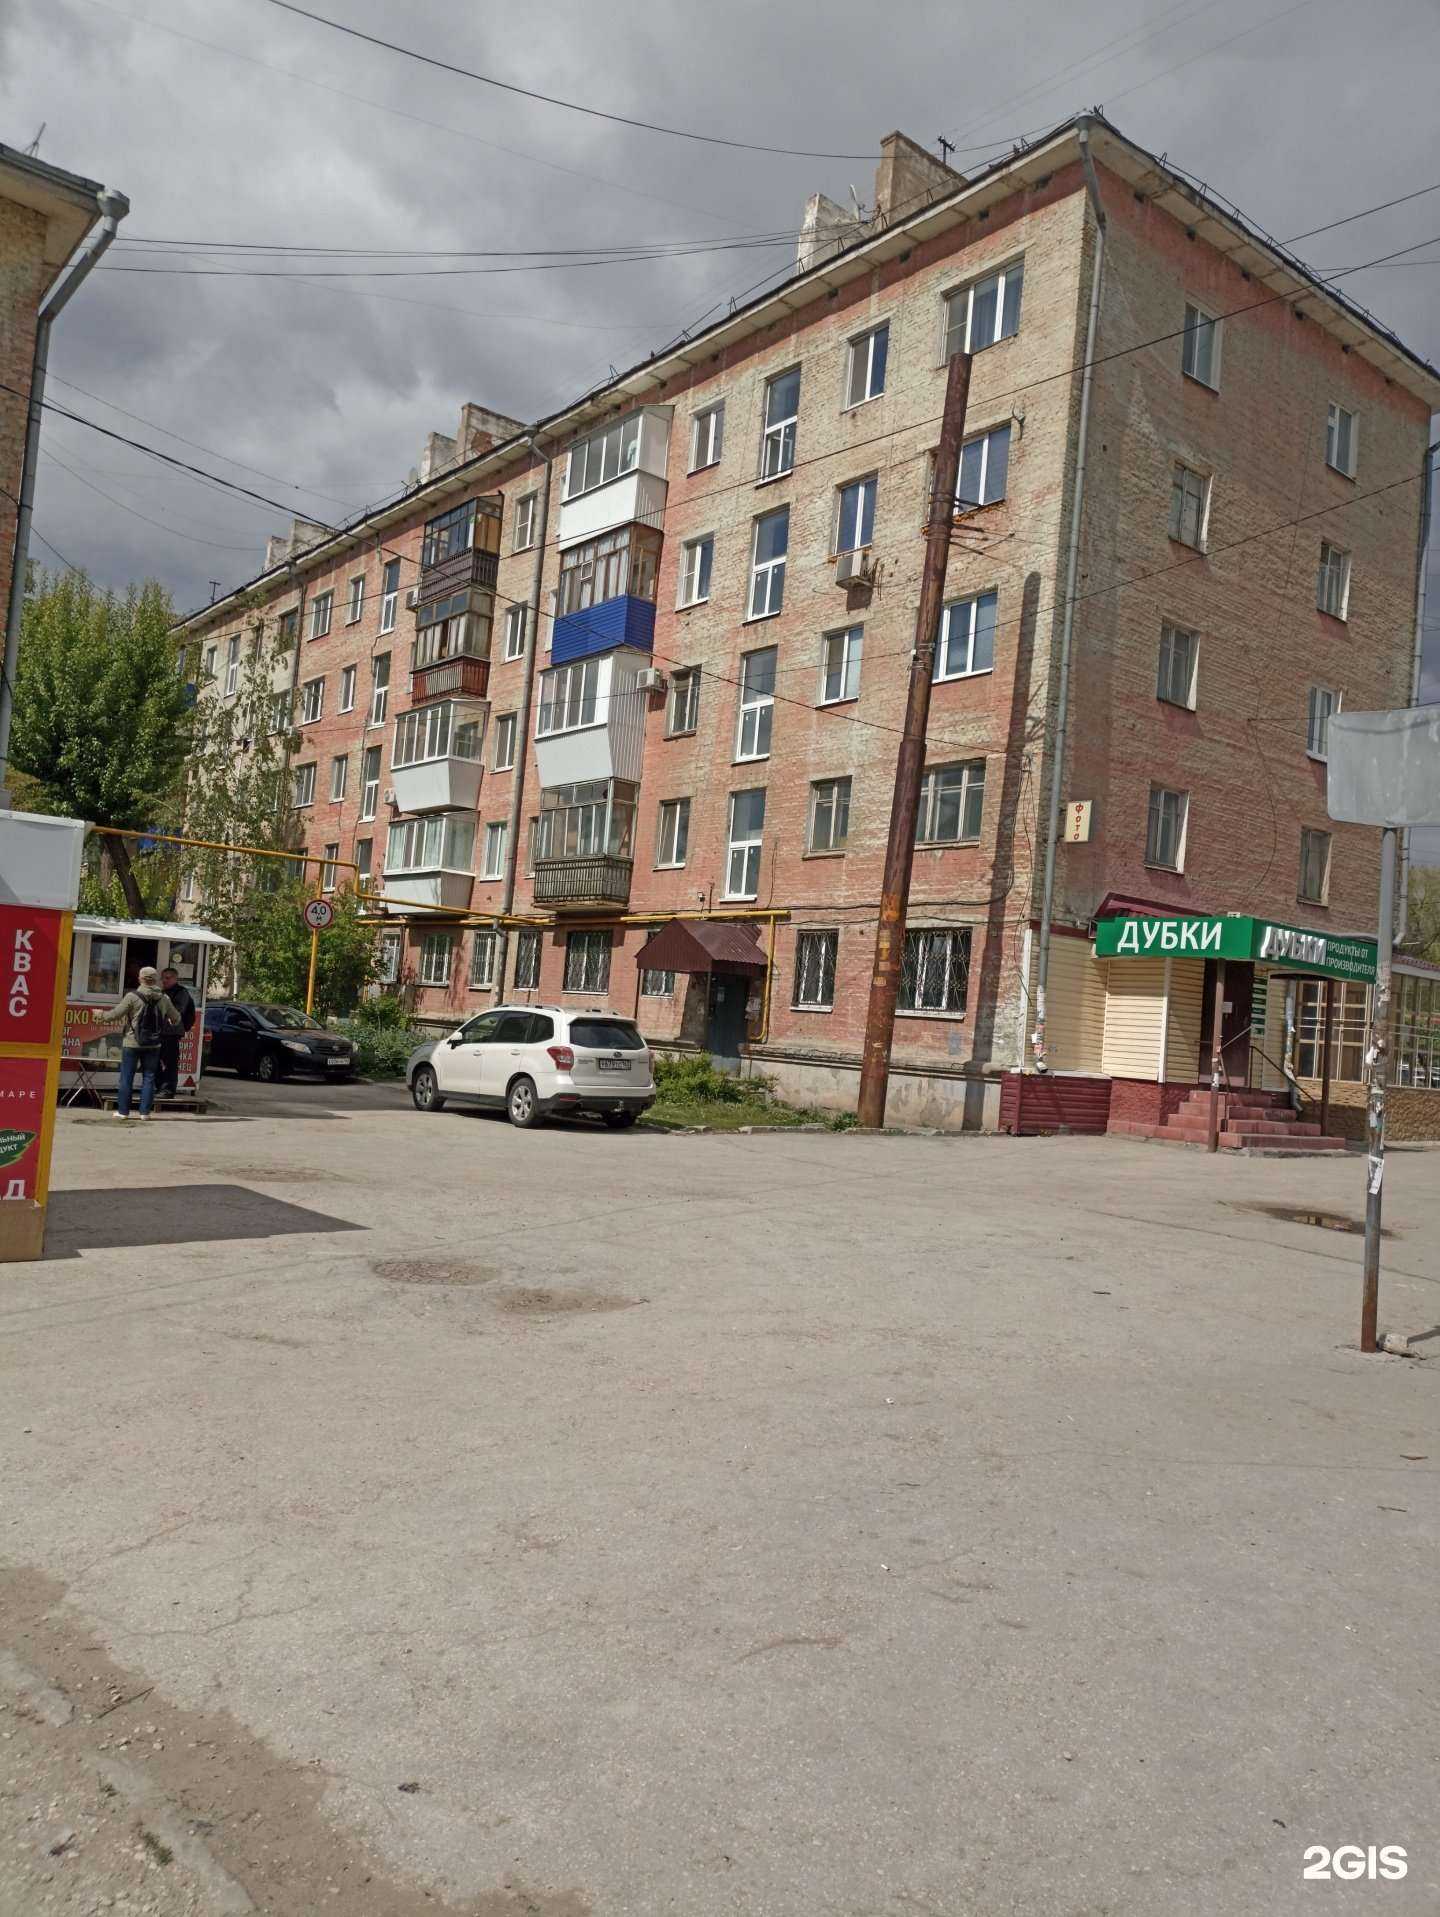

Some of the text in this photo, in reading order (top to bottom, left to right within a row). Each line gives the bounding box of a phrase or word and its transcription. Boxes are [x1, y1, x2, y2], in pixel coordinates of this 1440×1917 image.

[1073, 803, 1084, 840] ФОТО
[1117, 921, 1222, 954] ДУБКИ
[1260, 926, 1327, 966] ДУБКИ
[1327, 941, 1369, 959] ПРОДУКТЫ ОТ
[8, 929, 34, 1017] КВАС
[1326, 957, 1376, 976] ПРОИЗВОДИТЕЛЯ
[64, 1009, 89, 1025] ОКО
